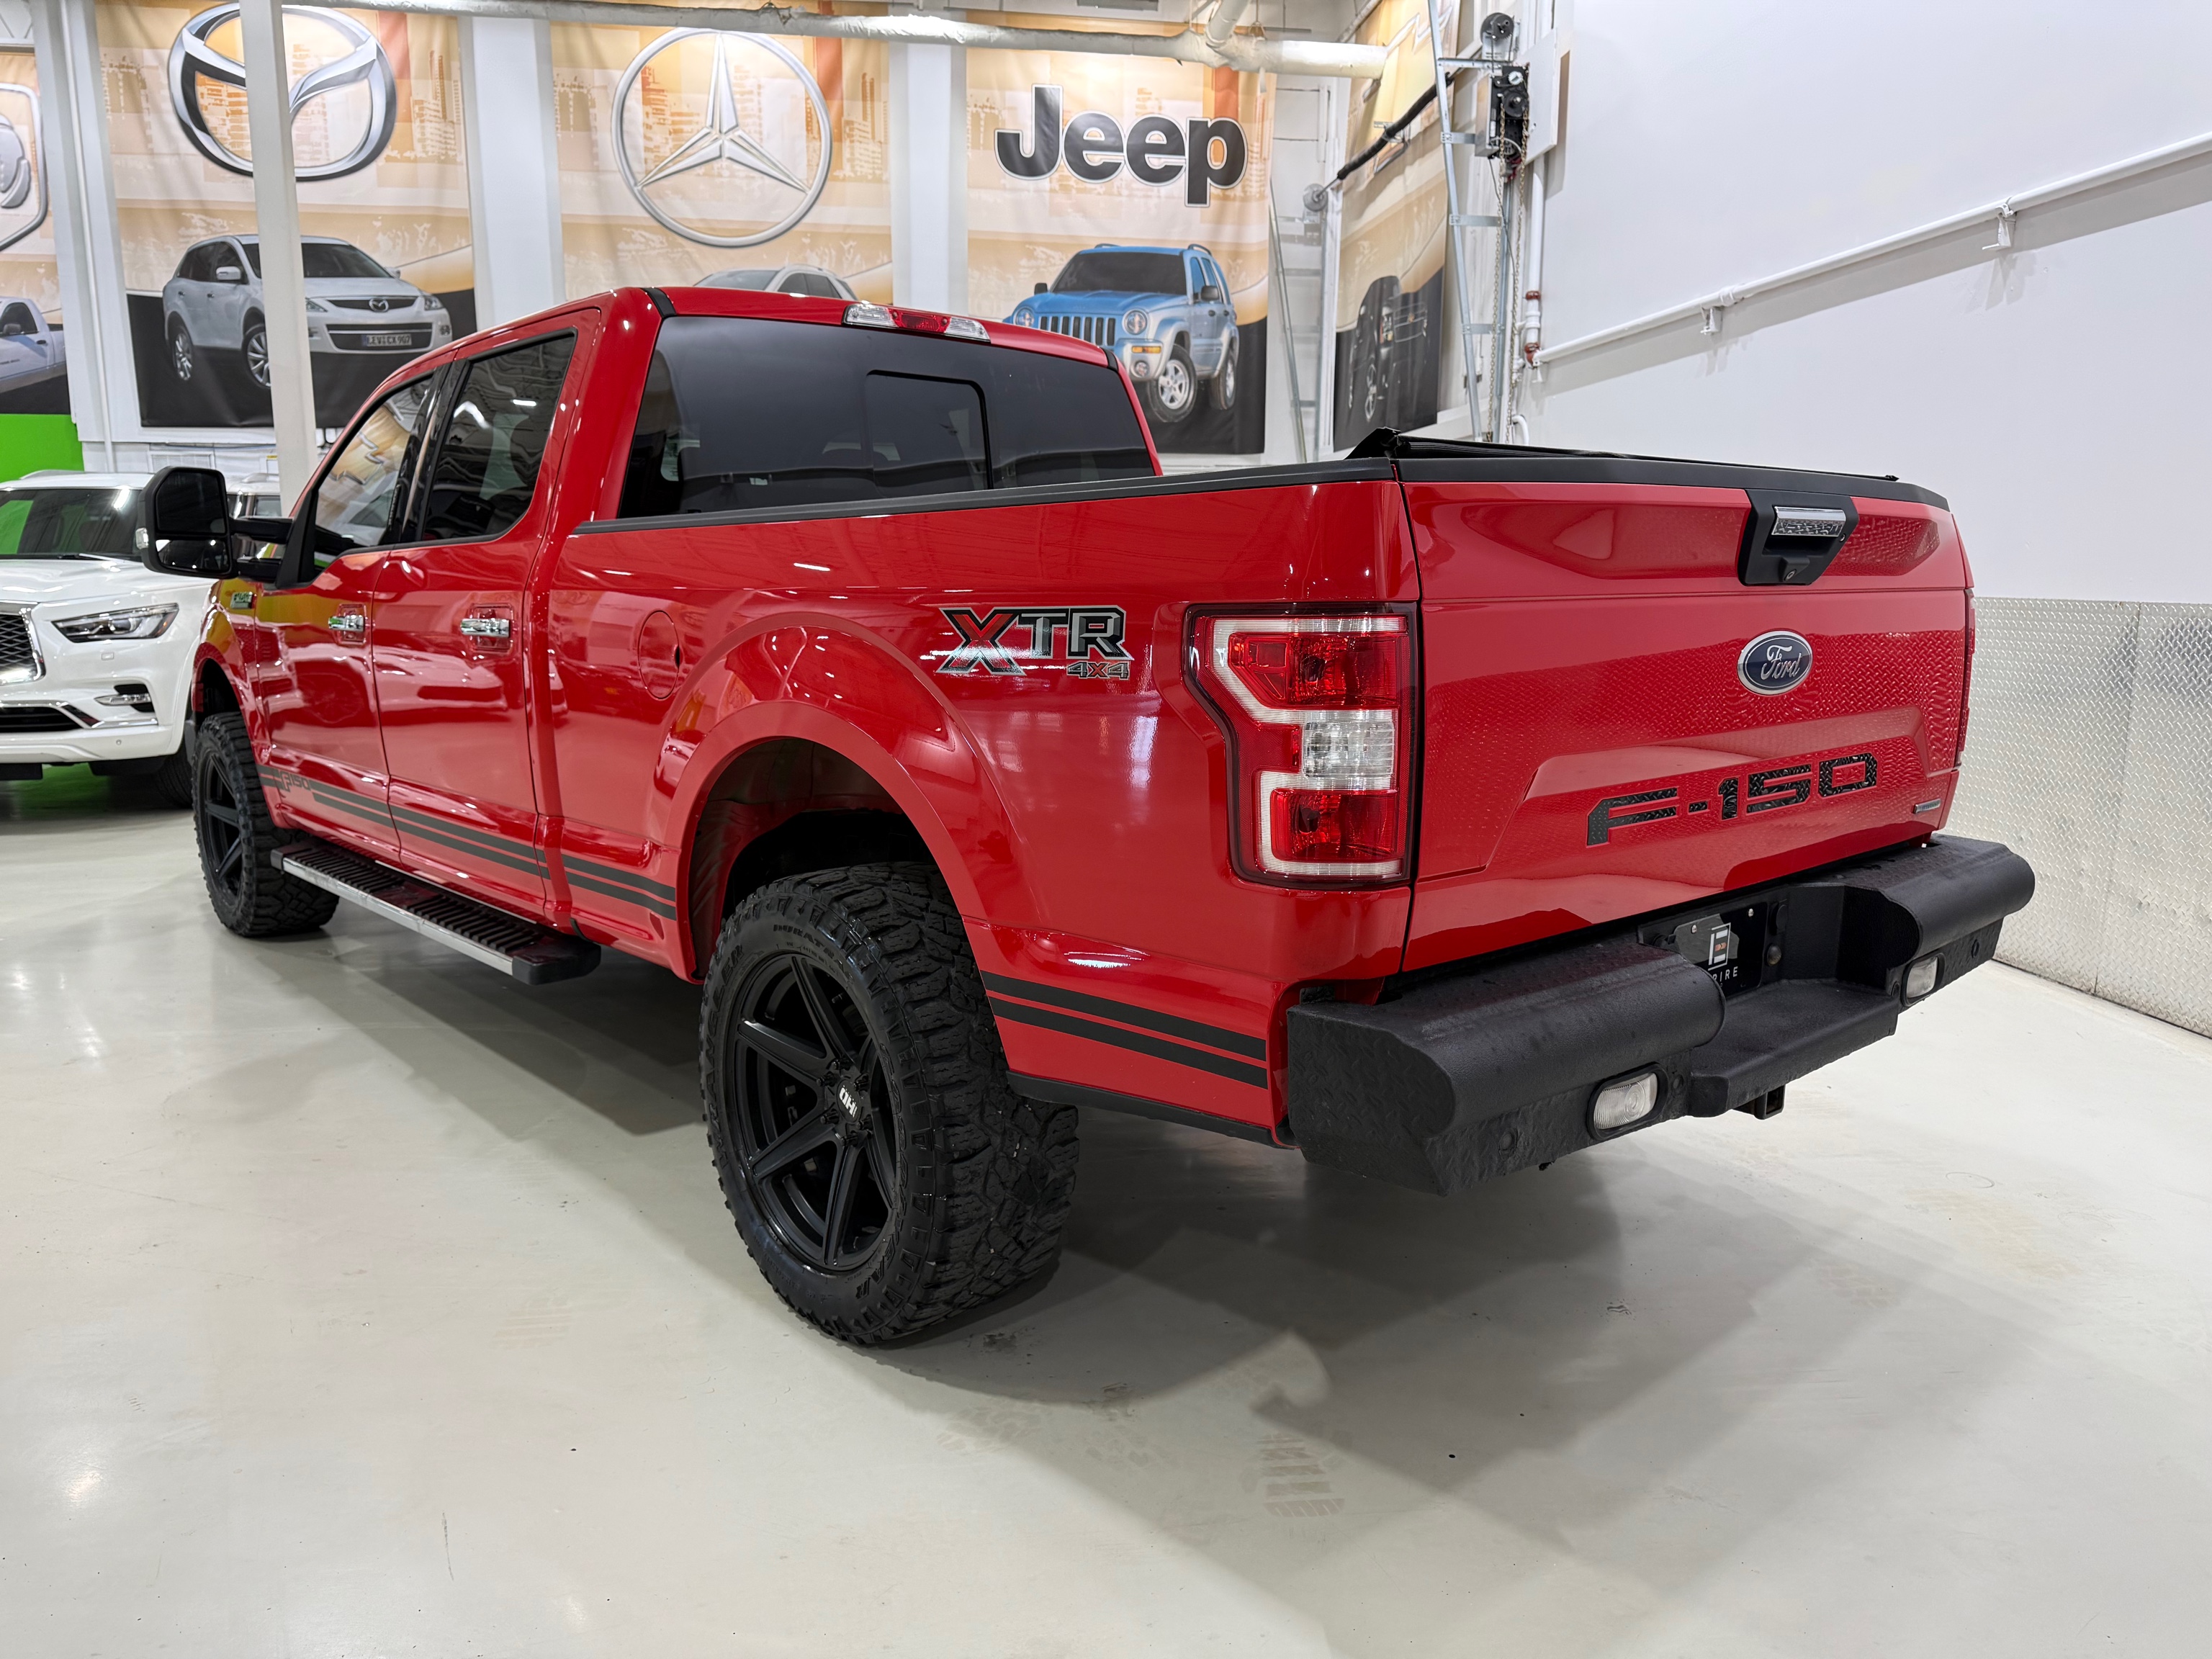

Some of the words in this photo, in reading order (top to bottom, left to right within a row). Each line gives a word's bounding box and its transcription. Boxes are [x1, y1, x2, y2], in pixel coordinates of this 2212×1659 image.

[995, 84, 1248, 207] Jeep
[937, 605, 1134, 675] XTR
[1761, 644, 1802, 680] Ford
[279, 770, 311, 793] F150
[1586, 752, 1878, 847] F-150
[1712, 966, 1738, 982] PIRE
